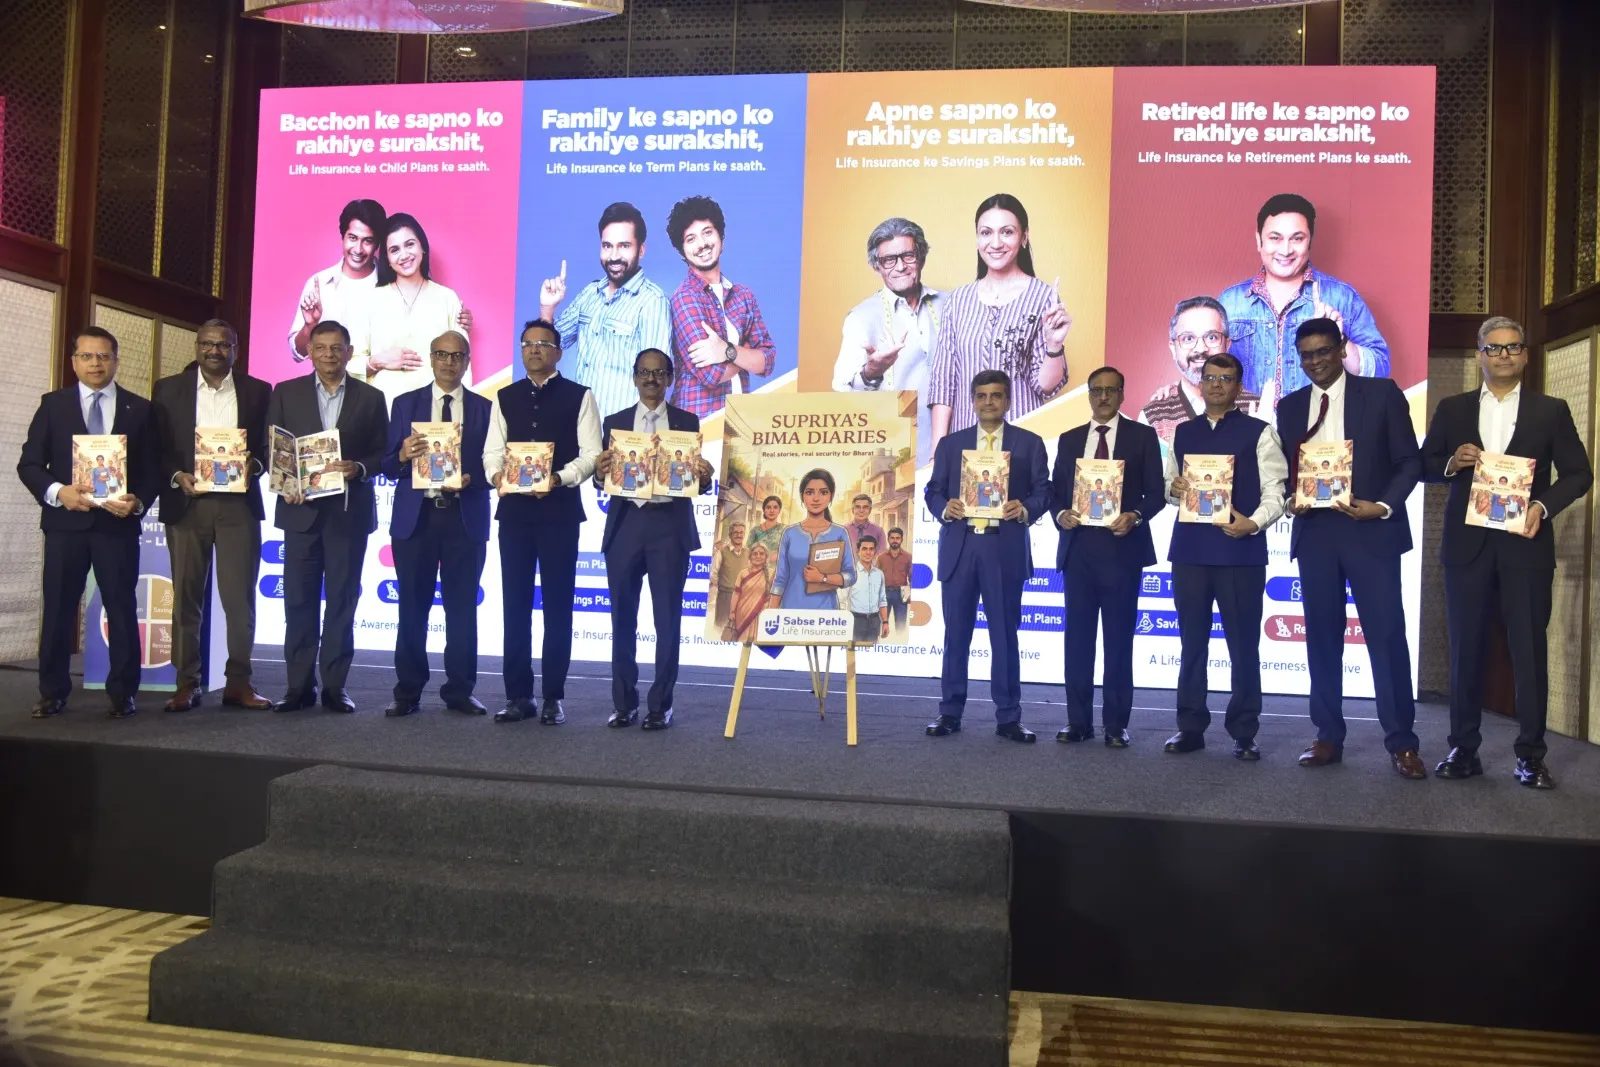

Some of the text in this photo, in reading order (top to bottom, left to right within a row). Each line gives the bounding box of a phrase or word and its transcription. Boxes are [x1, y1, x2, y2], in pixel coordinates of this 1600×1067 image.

[542, 105, 773, 132] Family ke sapno ko
[865, 98, 1056, 125] Apne sapno ko
[1142, 102, 1409, 124] Retired life ke sapno ko
[280, 108, 504, 132] Bacchon ke sapno ko
[847, 123, 1074, 149] rakhiye surakshit,
[1174, 123, 1375, 145] rakhiye surakshit,
[296, 132, 484, 157] rakhiye surakshit,
[550, 129, 763, 155] rakhiye surakshit,
[836, 155, 1085, 168] Life Insurance ke Savings Plans ke saath.
[1138, 151, 1411, 164] Life Insurance ke Retirement Plans ke saath.
[289, 161, 490, 175] Life Insurance ke Child Plans ke saath.
[546, 161, 766, 174] Life Insurance ke Term Plans ke saath.
[752, 430, 886, 445] BIMA DIARIES
[784, 616, 847, 626] Sabse Pehle
[1035, 613, 1062, 624] Plans
[782, 627, 846, 636] Life Insurance
[874, 642, 926, 654] Insurance
[1149, 654, 1157, 665] A
